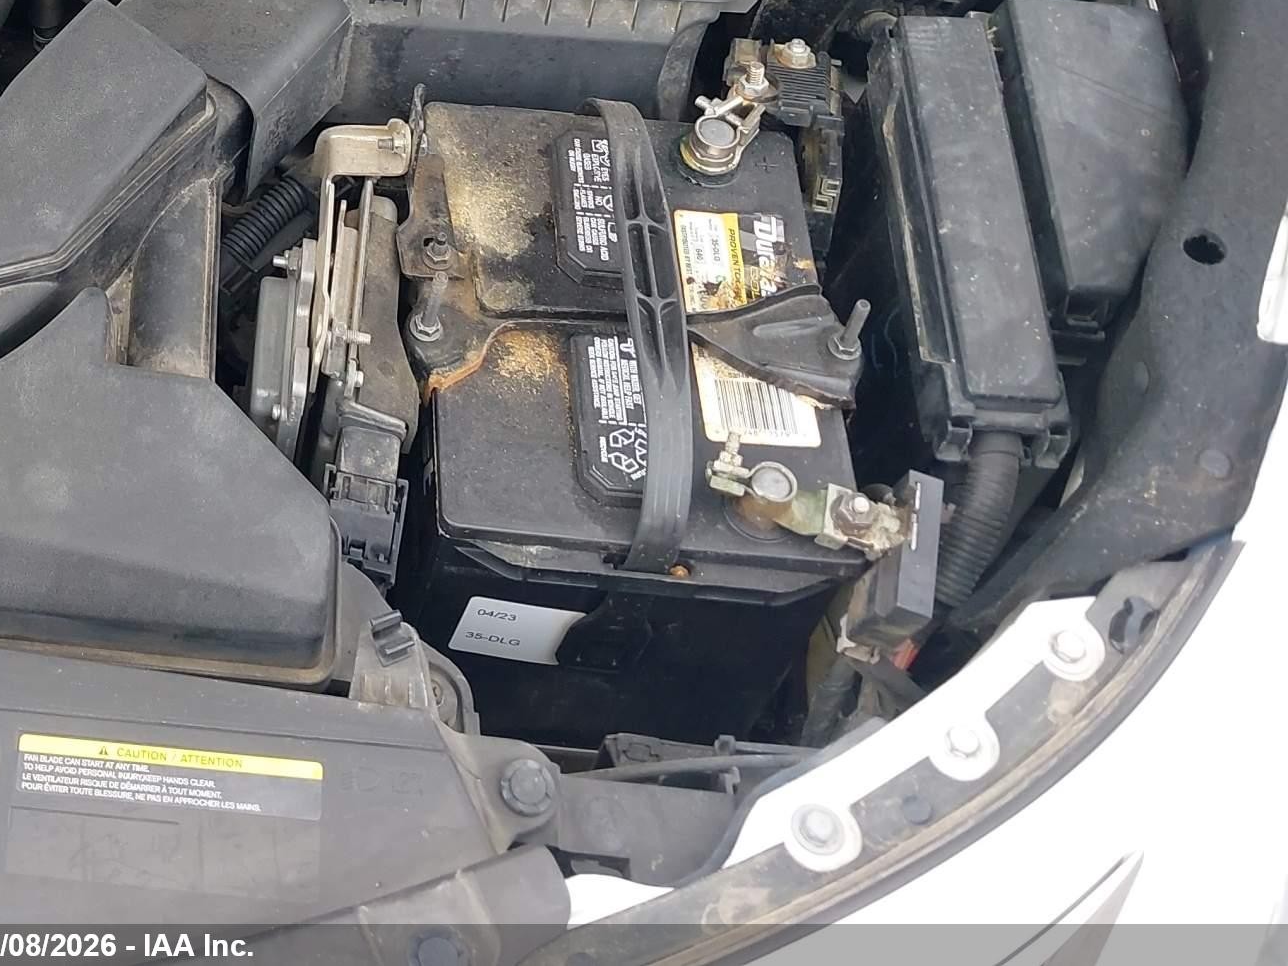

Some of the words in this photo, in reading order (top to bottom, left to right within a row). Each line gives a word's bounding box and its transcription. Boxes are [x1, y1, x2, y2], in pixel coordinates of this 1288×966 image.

[594, 196, 603, 205] NO
[728, 228, 739, 268] PROVEN
[621, 359, 630, 380] MEDICAL
[623, 382, 632, 394] HELP
[625, 396, 634, 409] FAST
[477, 609, 517, 622] 04/23
[465, 631, 521, 646] 35-DLG
[23, 754, 39, 762] FAN
[39, 755, 64, 764] BLADE
[64, 758, 81, 766] CAN
[81, 759, 104, 768] START
[115, 763, 130, 771] ANY
[131, 764, 150, 773] TIME.
[116, 748, 167, 761] CAUTION
[180, 754, 243, 768] ATTENTION
[23, 763, 34, 771] TO
[35, 764, 54, 773] HELP
[54, 766, 77, 775] AVOID
[78, 768, 117, 779] PERSONAL
[163, 776, 189, 785] HANDS
[190, 779, 216, 788] CLEAR.
[22, 773, 32, 781] LE
[32, 774, 79, 785] VENTILATEUR
[80, 778, 108, 788] RISQUE
[109, 781, 119, 789] DE
[168, 787, 188, 796] TOUT
[189, 789, 222, 799] MOMENT.
[21, 782, 43, 791] POUR
[70, 787, 93, 796] TOUTE
[135, 793, 146, 801] NE
[147, 794, 162, 802] PAS
[174, 797, 221, 808] APPROCHER
[222, 801, 235, 809] LES
[236, 803, 262, 812] MAINS.
